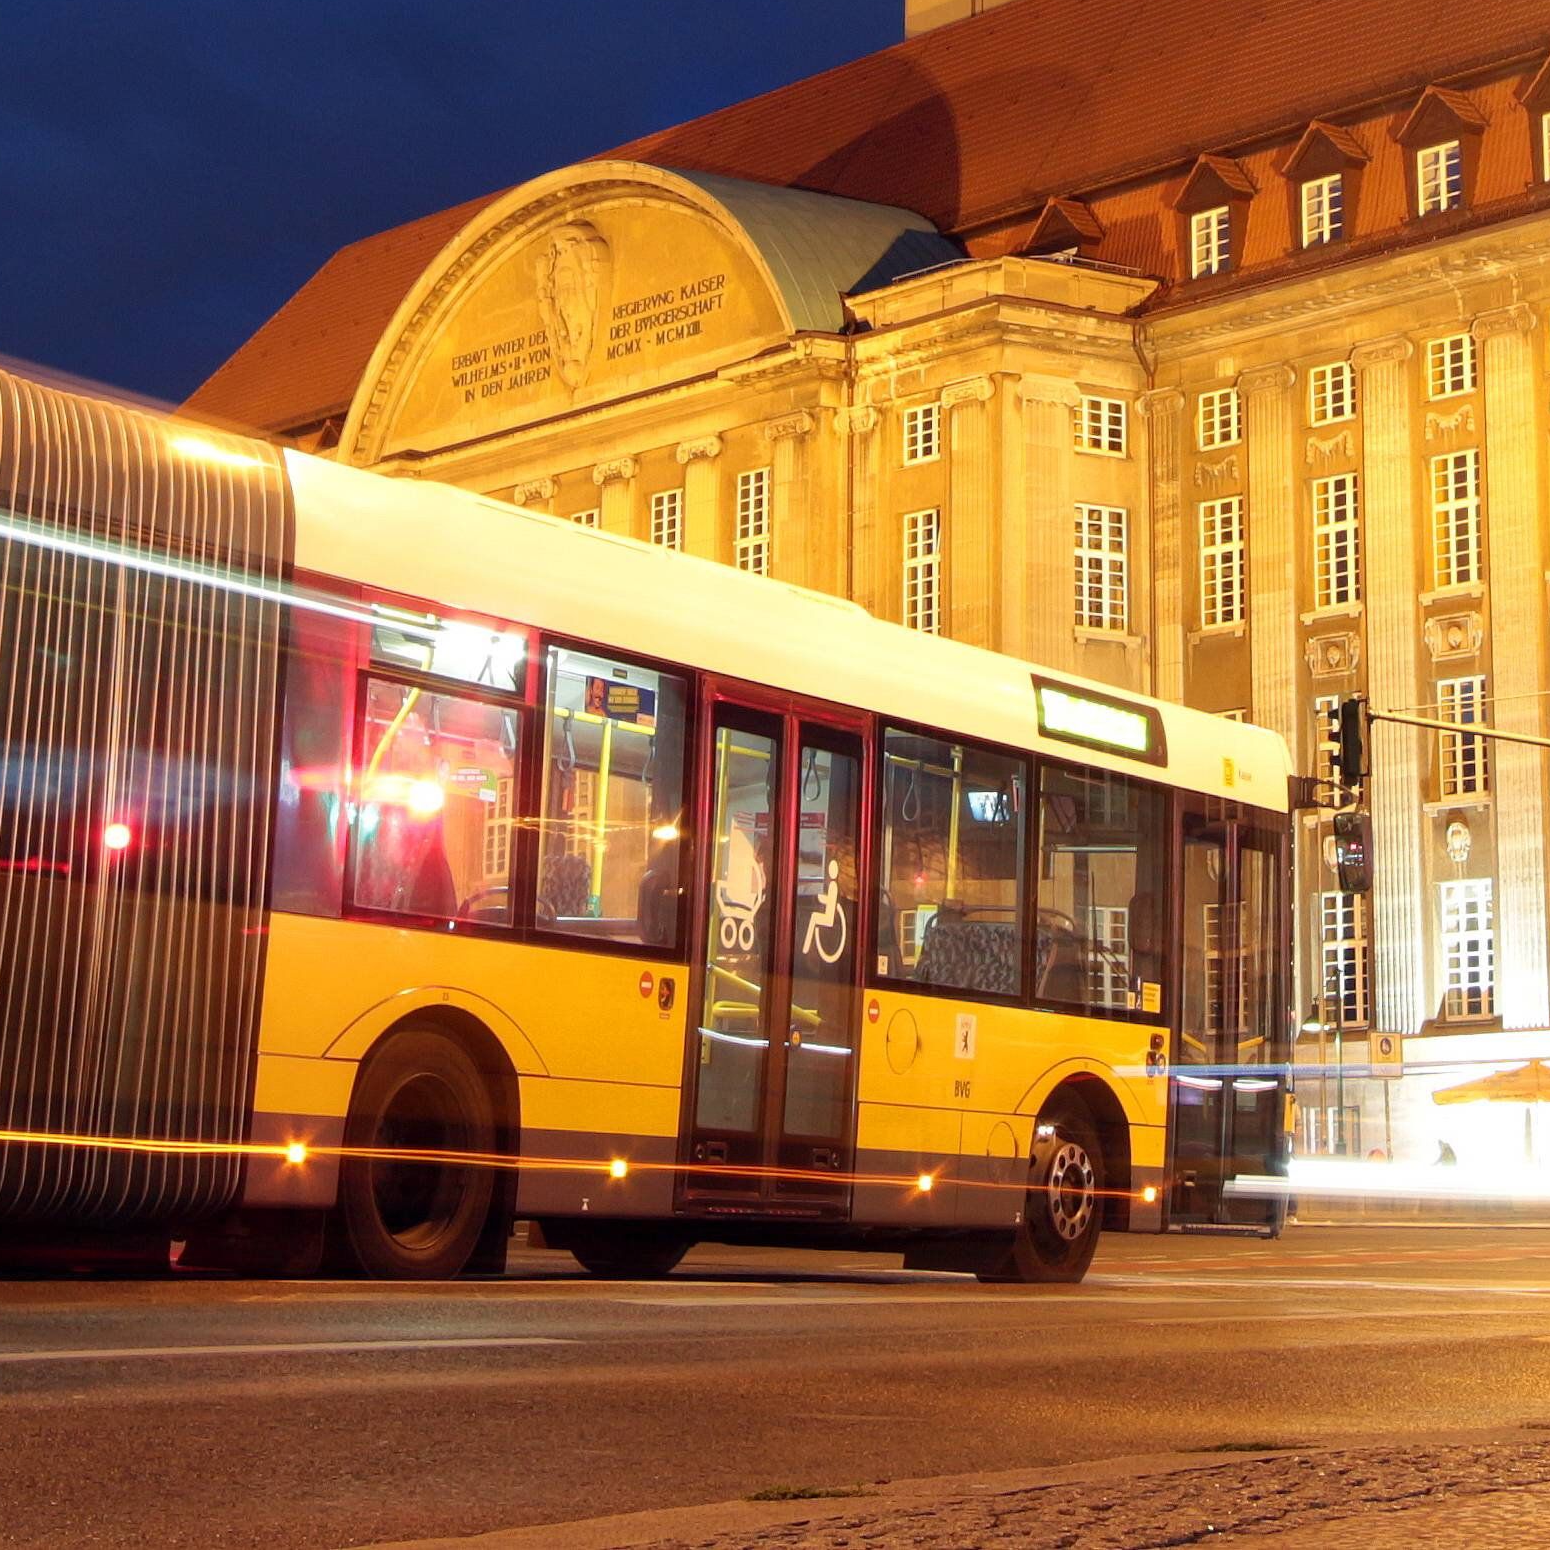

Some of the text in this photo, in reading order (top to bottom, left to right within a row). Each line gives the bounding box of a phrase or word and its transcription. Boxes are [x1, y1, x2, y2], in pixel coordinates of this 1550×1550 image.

[680, 274, 725, 301] KAISER
[451, 361, 507, 387] WILHELMS
[528, 346, 551, 365] VON
[609, 322, 631, 341] DER
[465, 388, 475, 403] IN
[481, 379, 503, 398] DEN
[507, 365, 551, 391] JAHREN
[606, 337, 641, 361] MCMX
[954, 1079, 971, 1099] BVG
